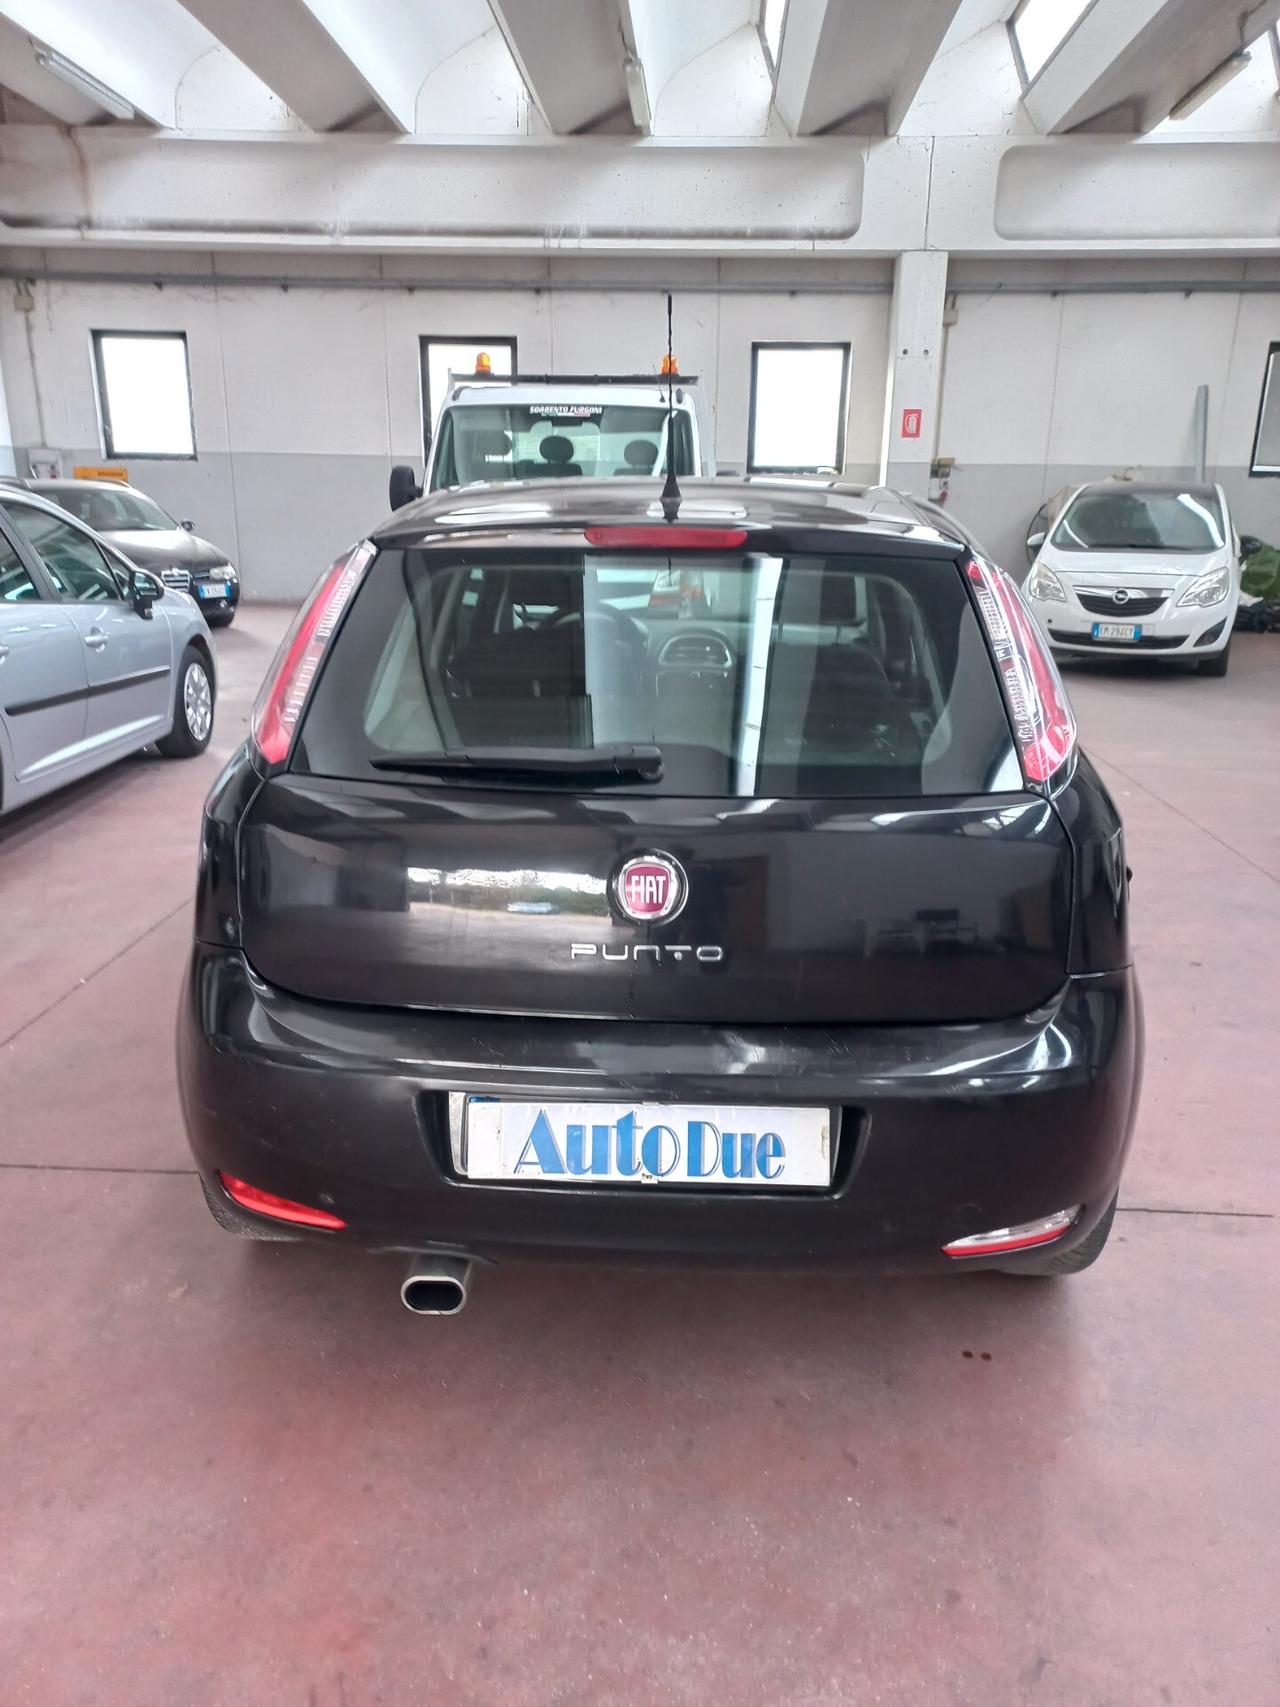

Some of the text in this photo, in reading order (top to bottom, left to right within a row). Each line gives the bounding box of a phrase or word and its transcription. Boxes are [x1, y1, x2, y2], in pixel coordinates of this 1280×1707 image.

[529, 405, 568, 414] SORRENTO
[569, 406, 603, 415] FURGONI
[631, 875, 667, 903] FIAT
[571, 944, 724, 961] PUNTO
